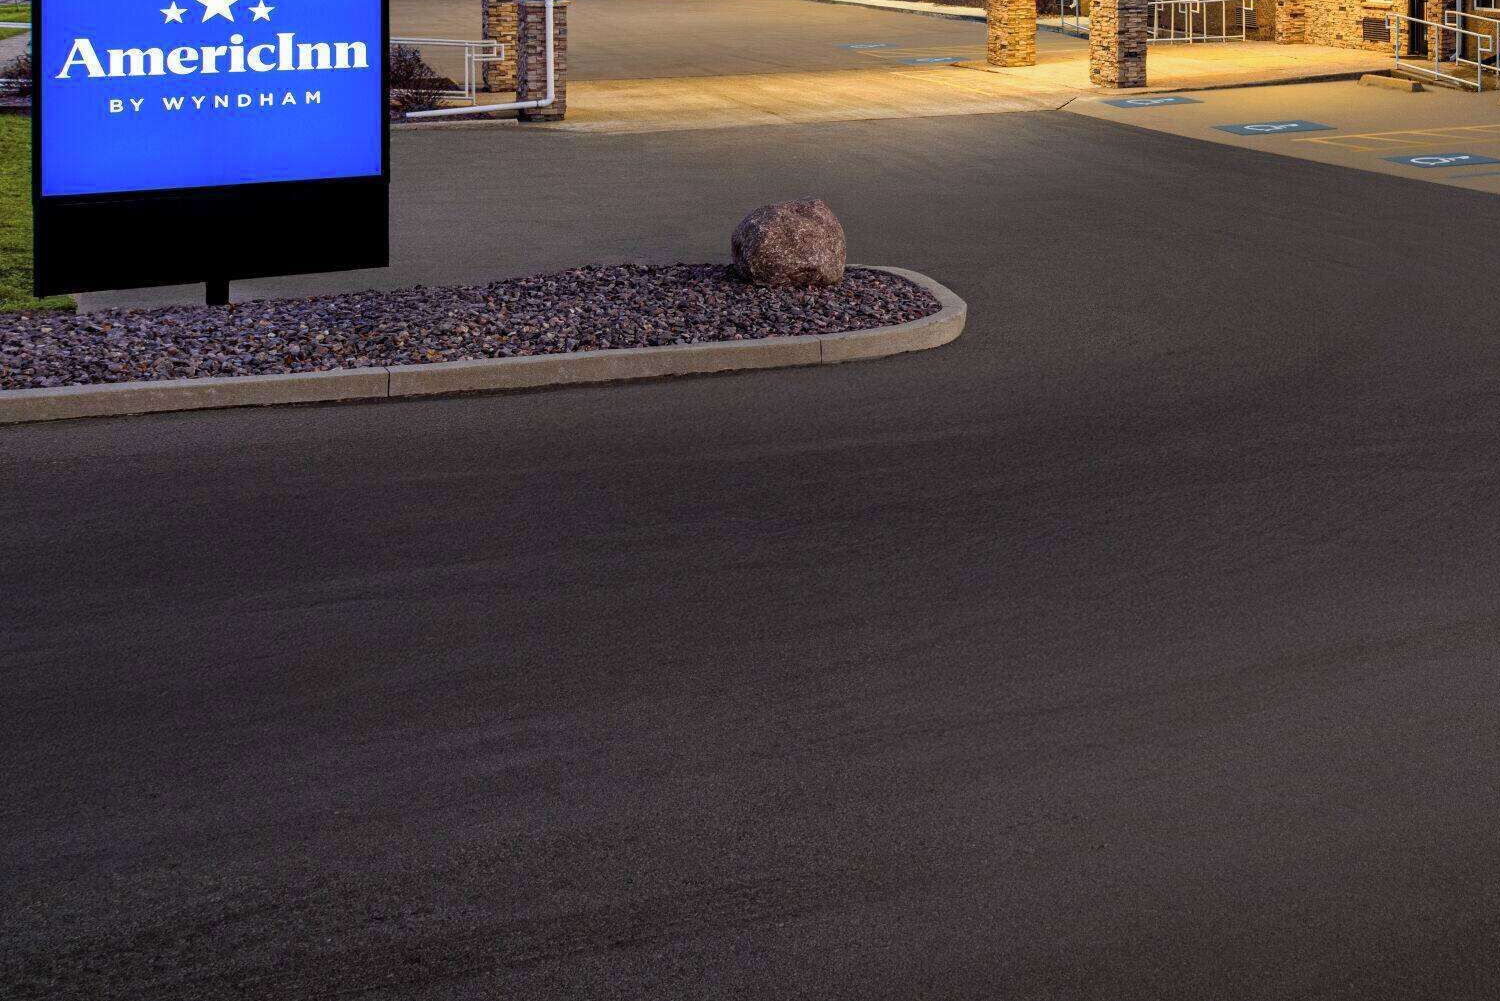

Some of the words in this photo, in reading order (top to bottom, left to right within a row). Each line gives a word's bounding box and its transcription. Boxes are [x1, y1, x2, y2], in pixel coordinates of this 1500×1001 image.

[55, 32, 369, 79] AmericInn
[109, 98, 145, 113] BY
[162, 90, 321, 111] WYNDHAM
